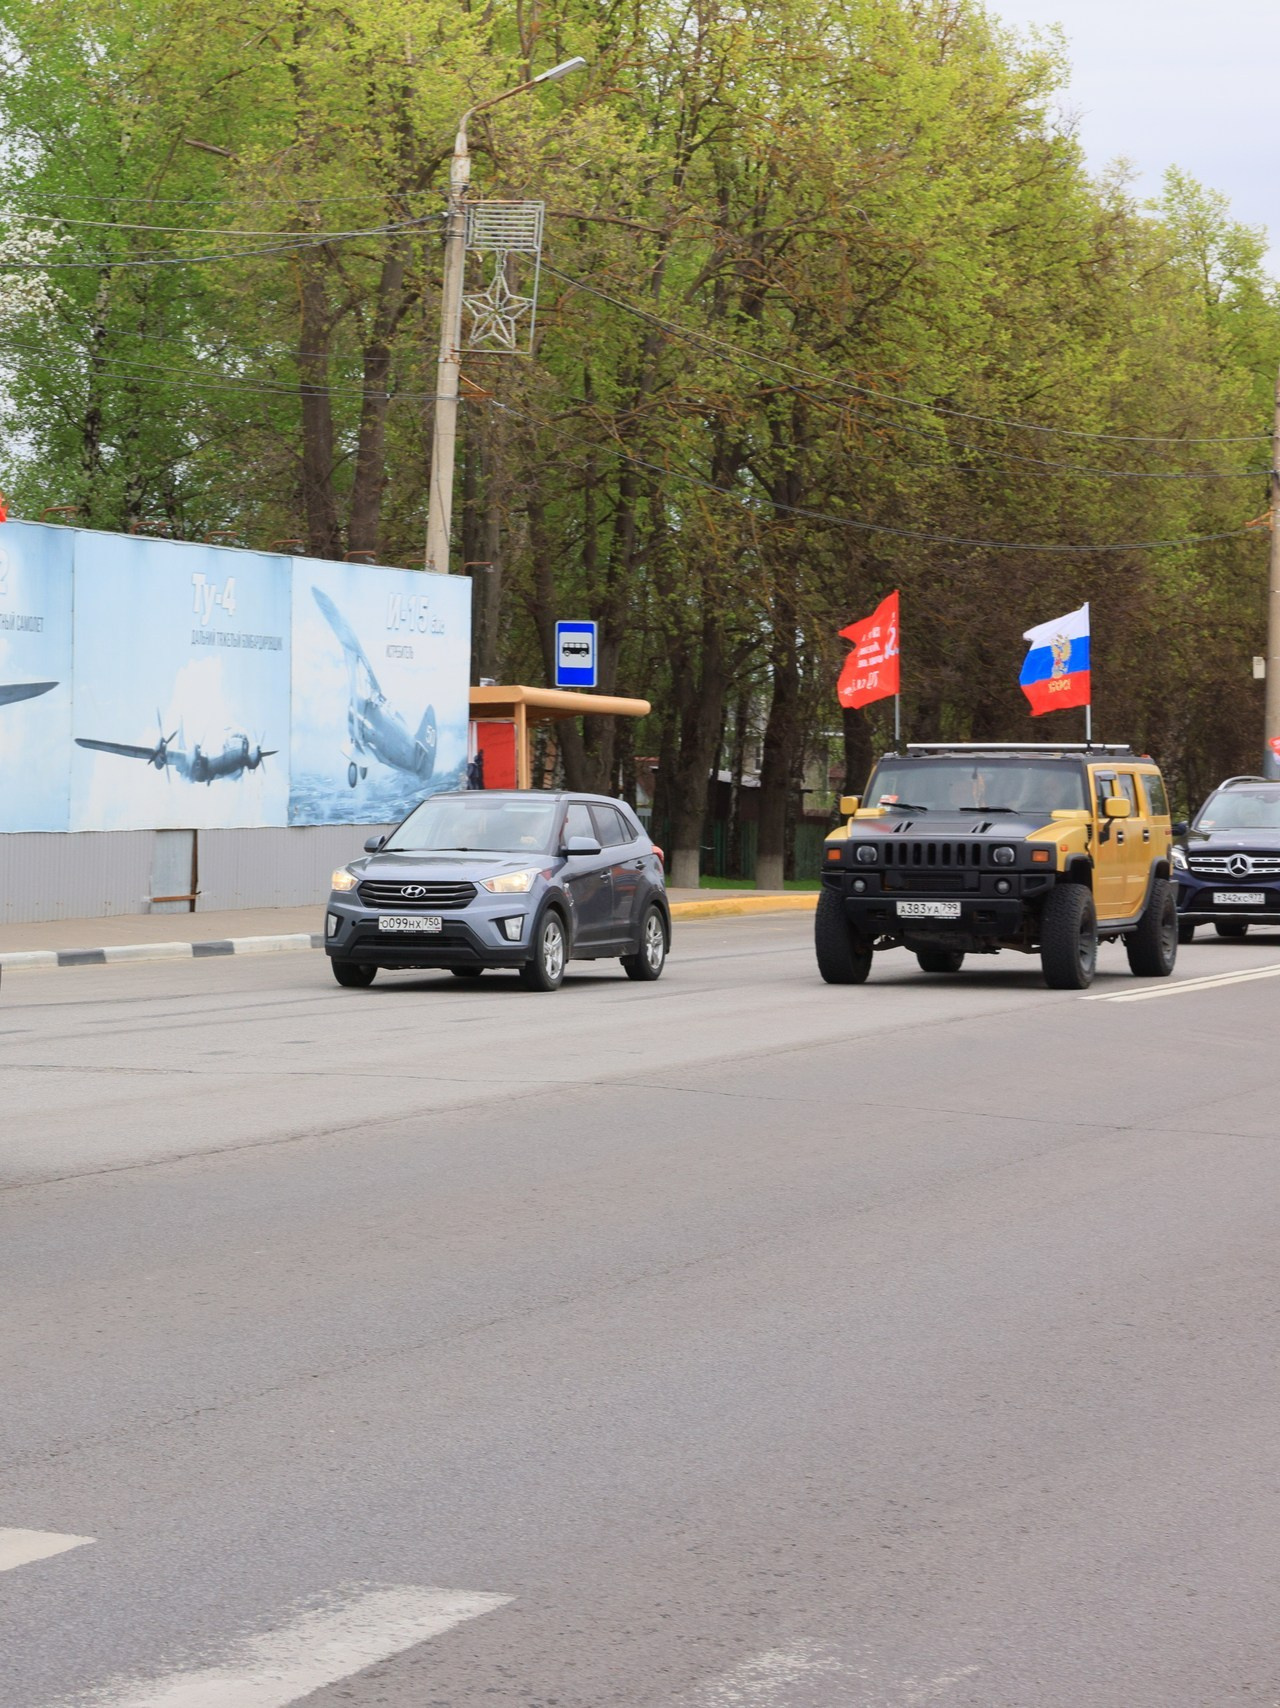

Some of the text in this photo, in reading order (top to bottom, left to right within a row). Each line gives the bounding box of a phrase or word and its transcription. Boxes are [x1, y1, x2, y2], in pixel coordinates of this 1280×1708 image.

[192, 571, 237, 628] Ту-4
[386, 591, 430, 634] И-15
[382, 917, 439, 929] О099НХ 750
